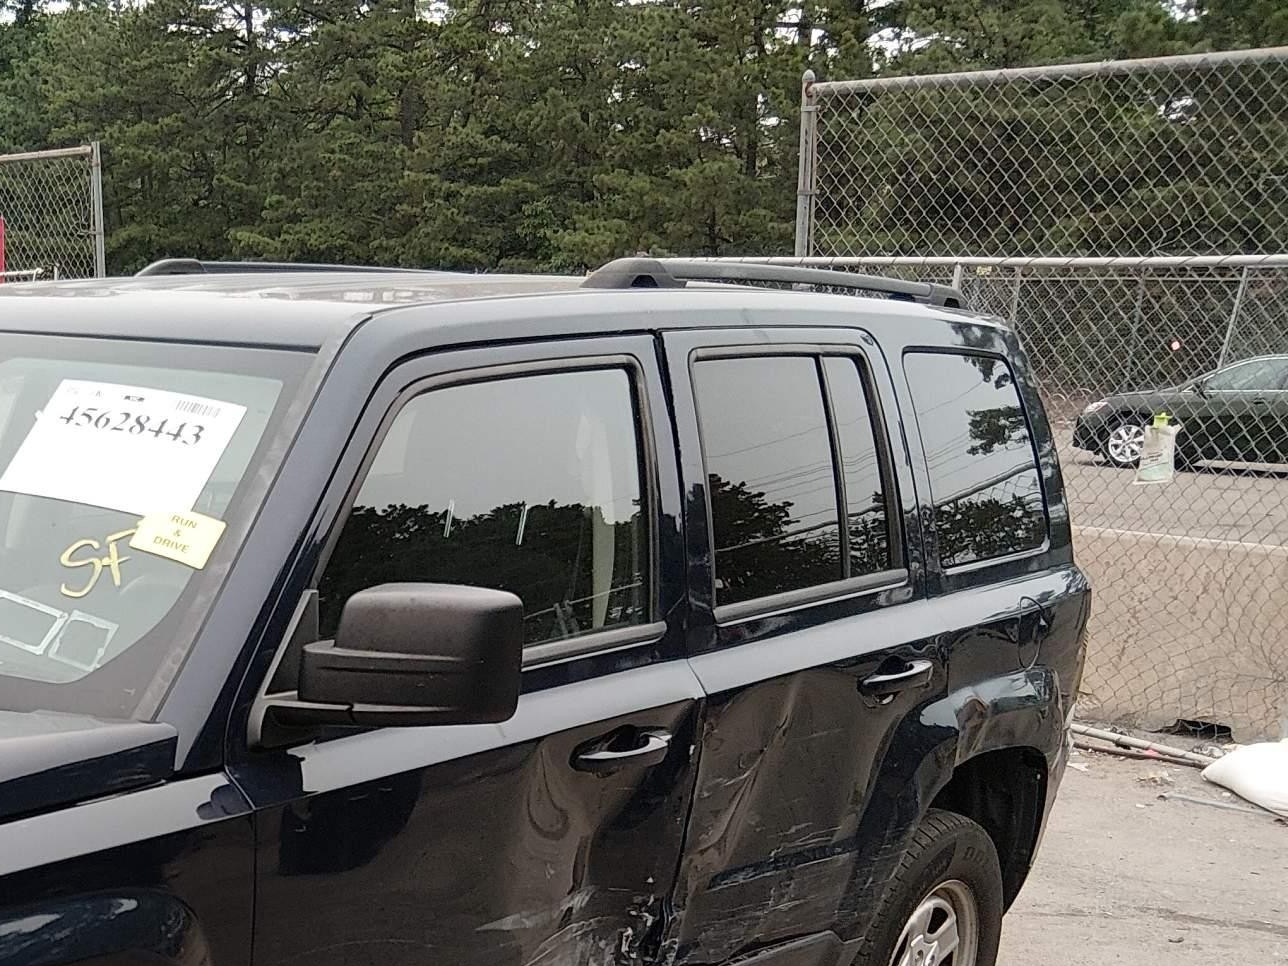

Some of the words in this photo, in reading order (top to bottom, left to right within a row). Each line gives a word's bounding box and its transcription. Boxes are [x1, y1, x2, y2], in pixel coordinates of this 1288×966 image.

[60, 405, 205, 446] 45628443
[171, 514, 198, 529] RUN
[153, 535, 191, 554] DRIVE
